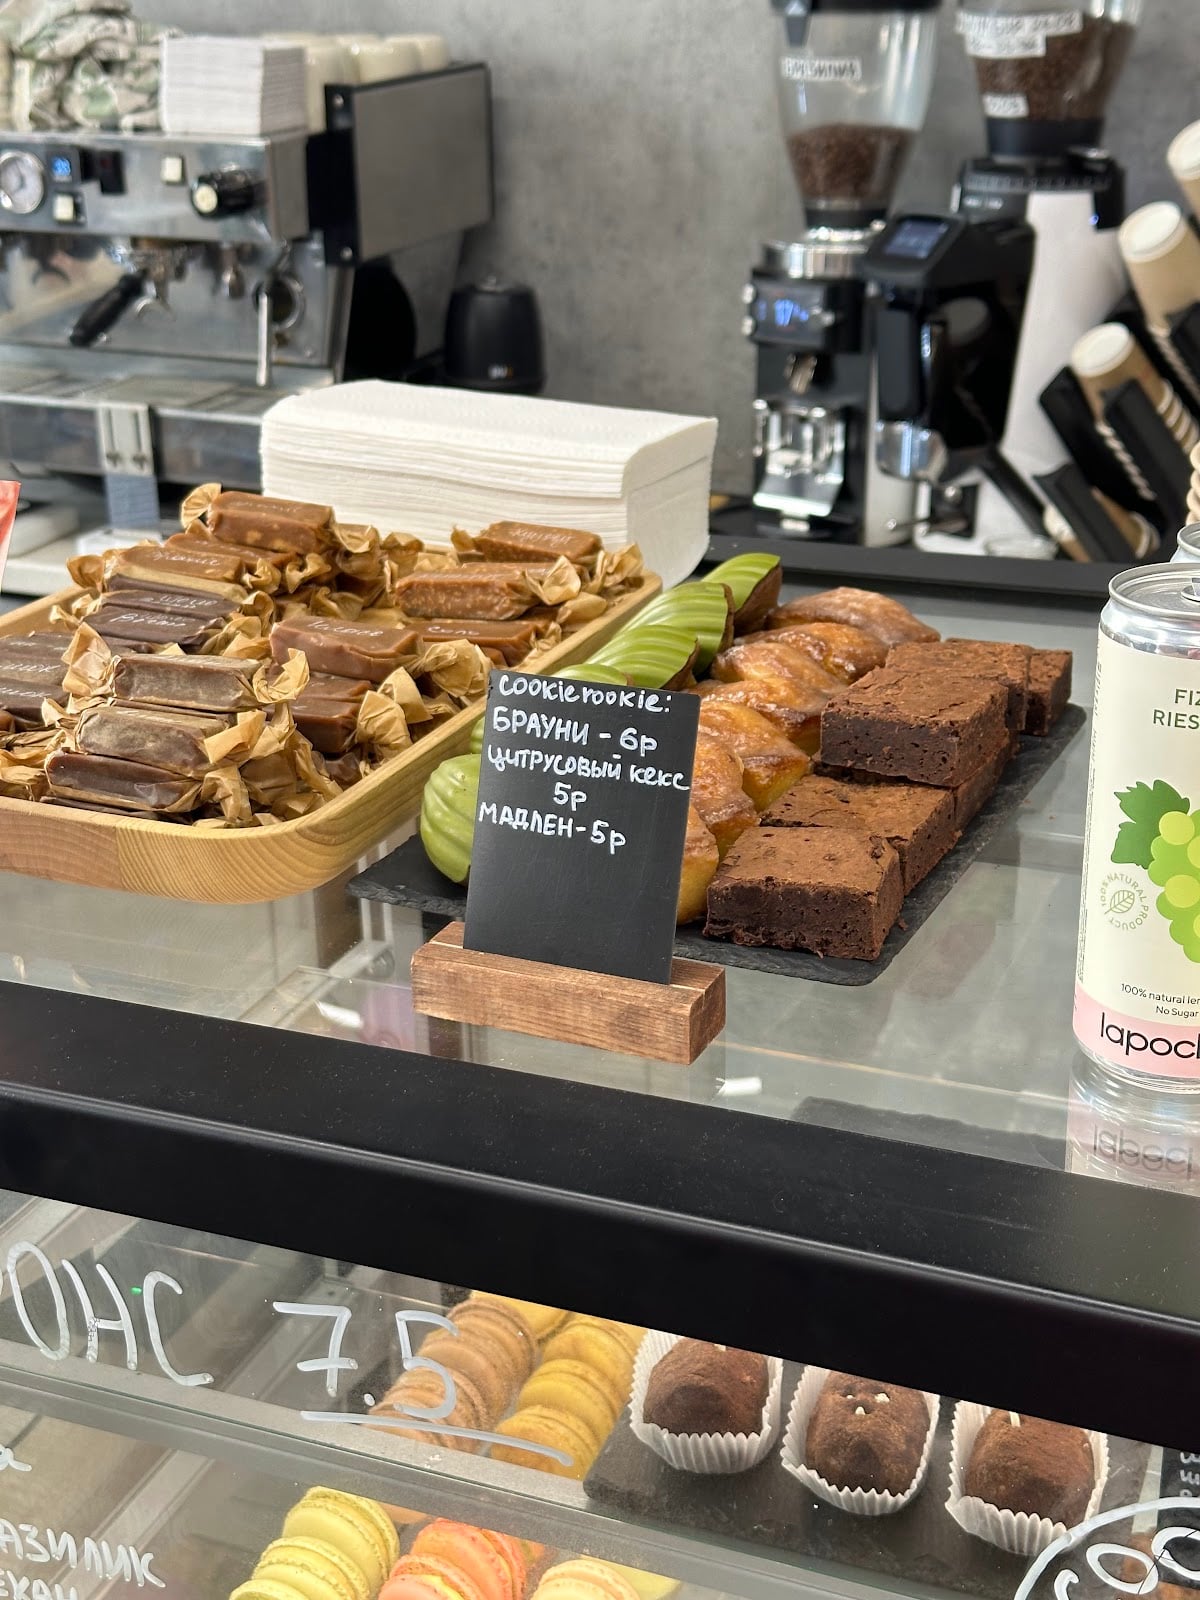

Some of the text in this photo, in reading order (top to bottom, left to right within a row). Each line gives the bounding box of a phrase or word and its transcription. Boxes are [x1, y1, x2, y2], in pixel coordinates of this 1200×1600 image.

[492, 706, 590, 746] БРАУНИ
[1153, 708, 1200, 730] RIES
[1106, 873, 1147, 903] NATURAL
[1108, 904, 1149, 931] PRODUCT
[1121, 983, 1147, 998] 100%
[1148, 992, 1185, 1004] natural
[1155, 1005, 1199, 1019] No Sugar
[0, 1240, 459, 1420] ОНС 7.5
